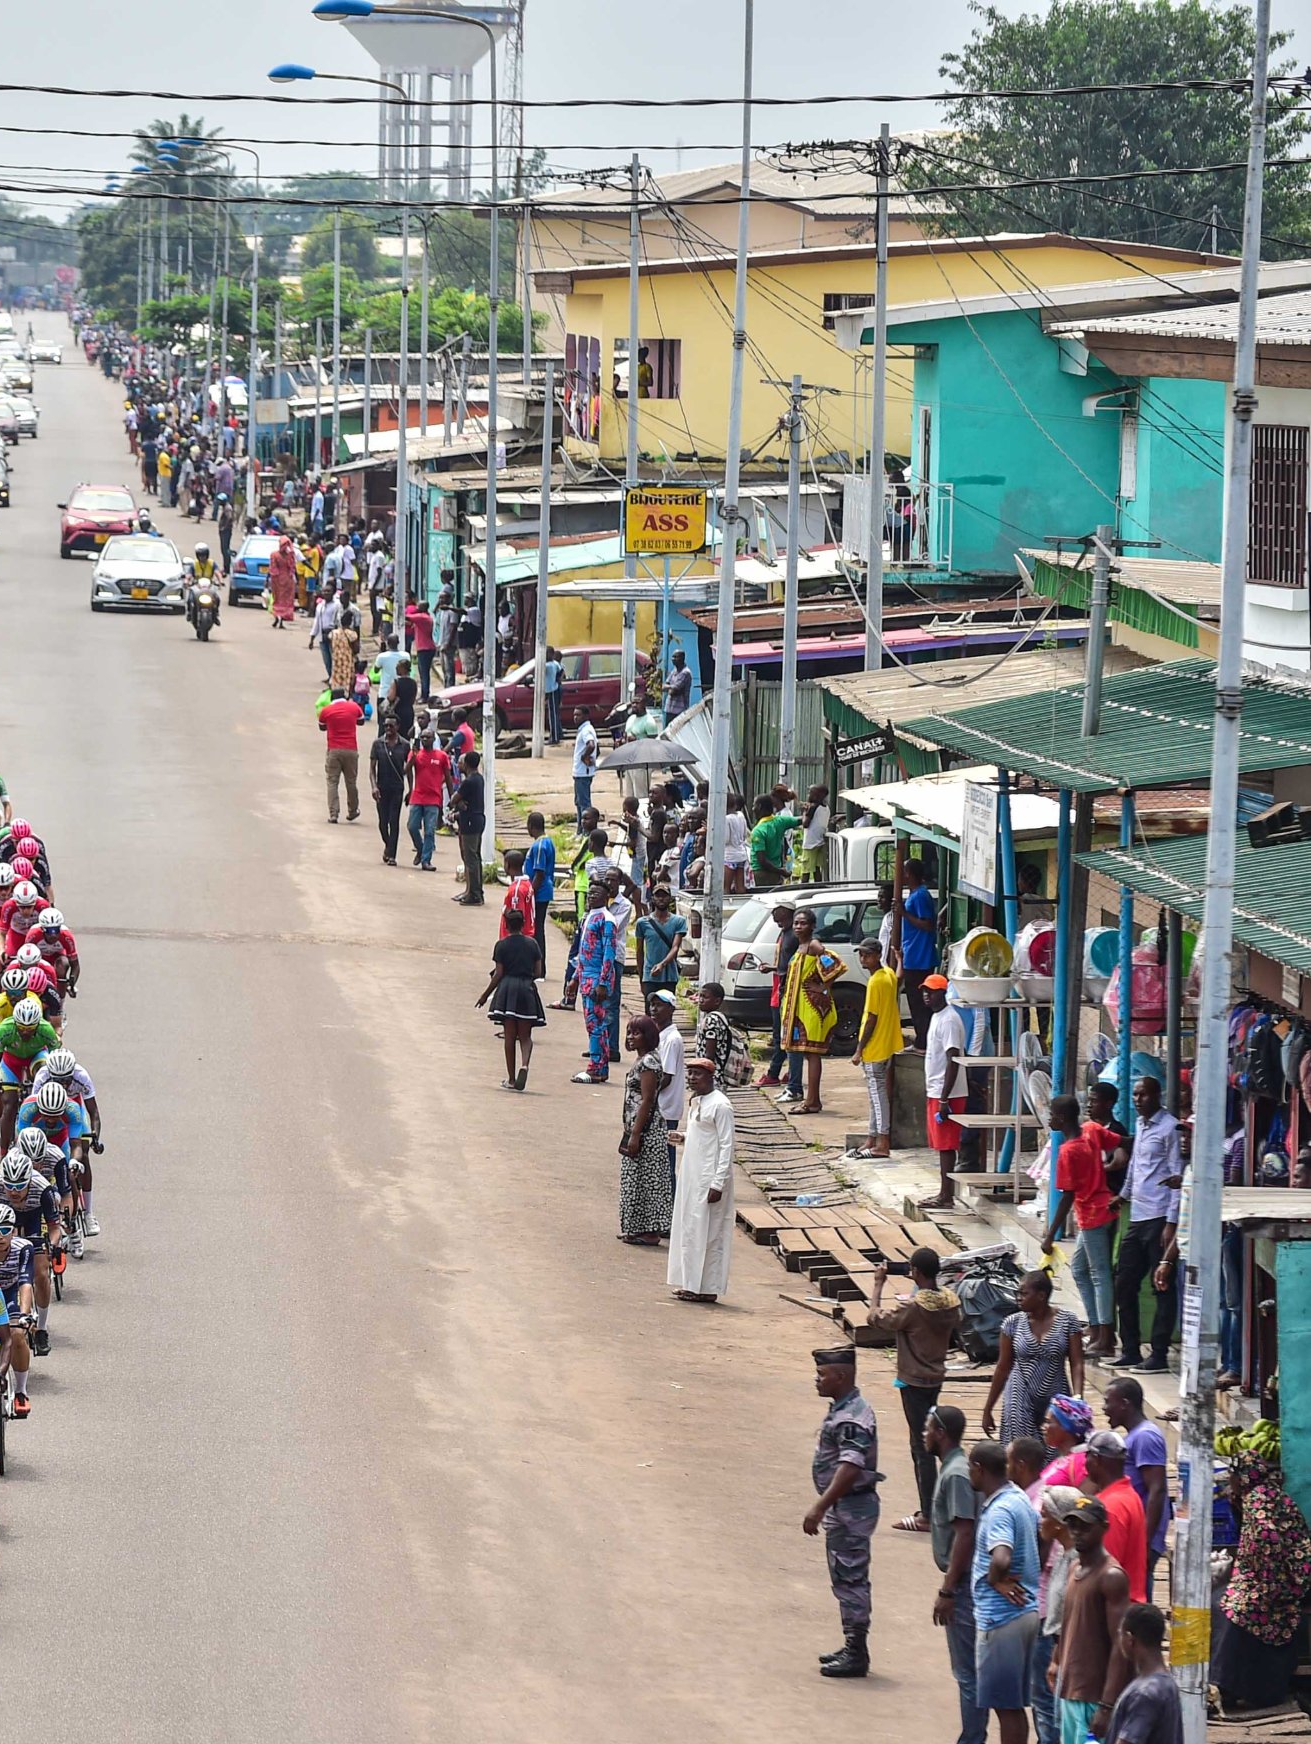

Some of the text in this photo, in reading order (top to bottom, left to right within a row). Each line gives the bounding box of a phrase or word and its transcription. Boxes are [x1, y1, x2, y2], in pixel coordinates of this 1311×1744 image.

[630, 493, 703, 506] BIJOUTERIE
[642, 514, 689, 532] ASS
[836, 737, 884, 757] CANAL+
